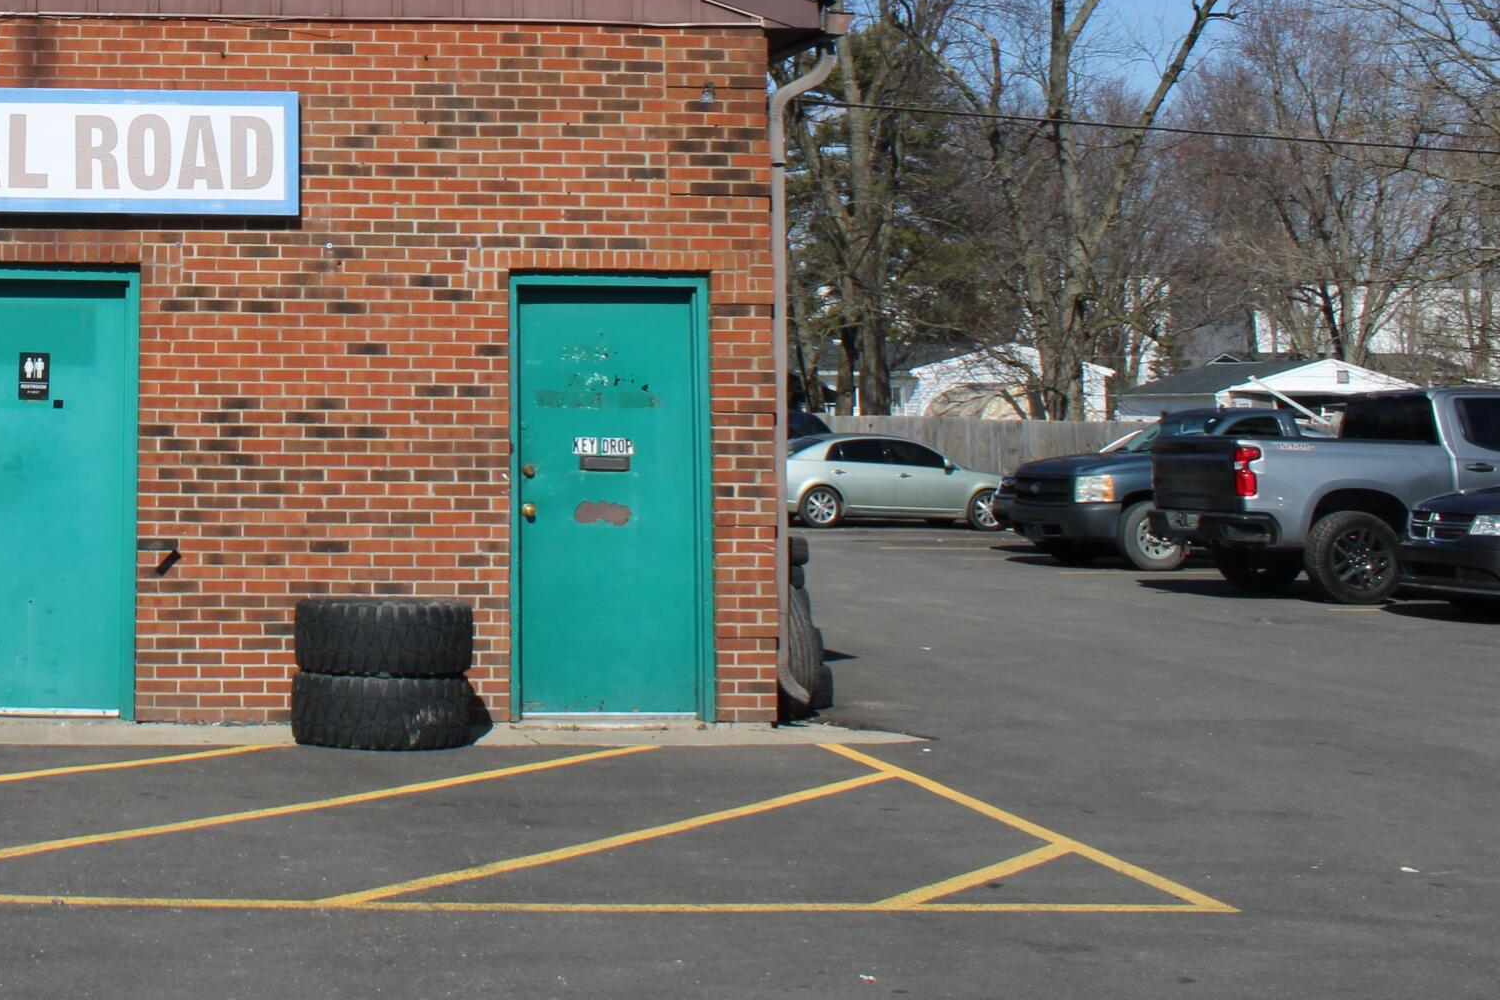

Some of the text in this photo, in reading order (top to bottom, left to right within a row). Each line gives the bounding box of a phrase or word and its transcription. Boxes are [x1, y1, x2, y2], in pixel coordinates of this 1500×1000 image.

[74, 113, 274, 191] ROAD
[572, 438, 633, 453] KEY DROP
